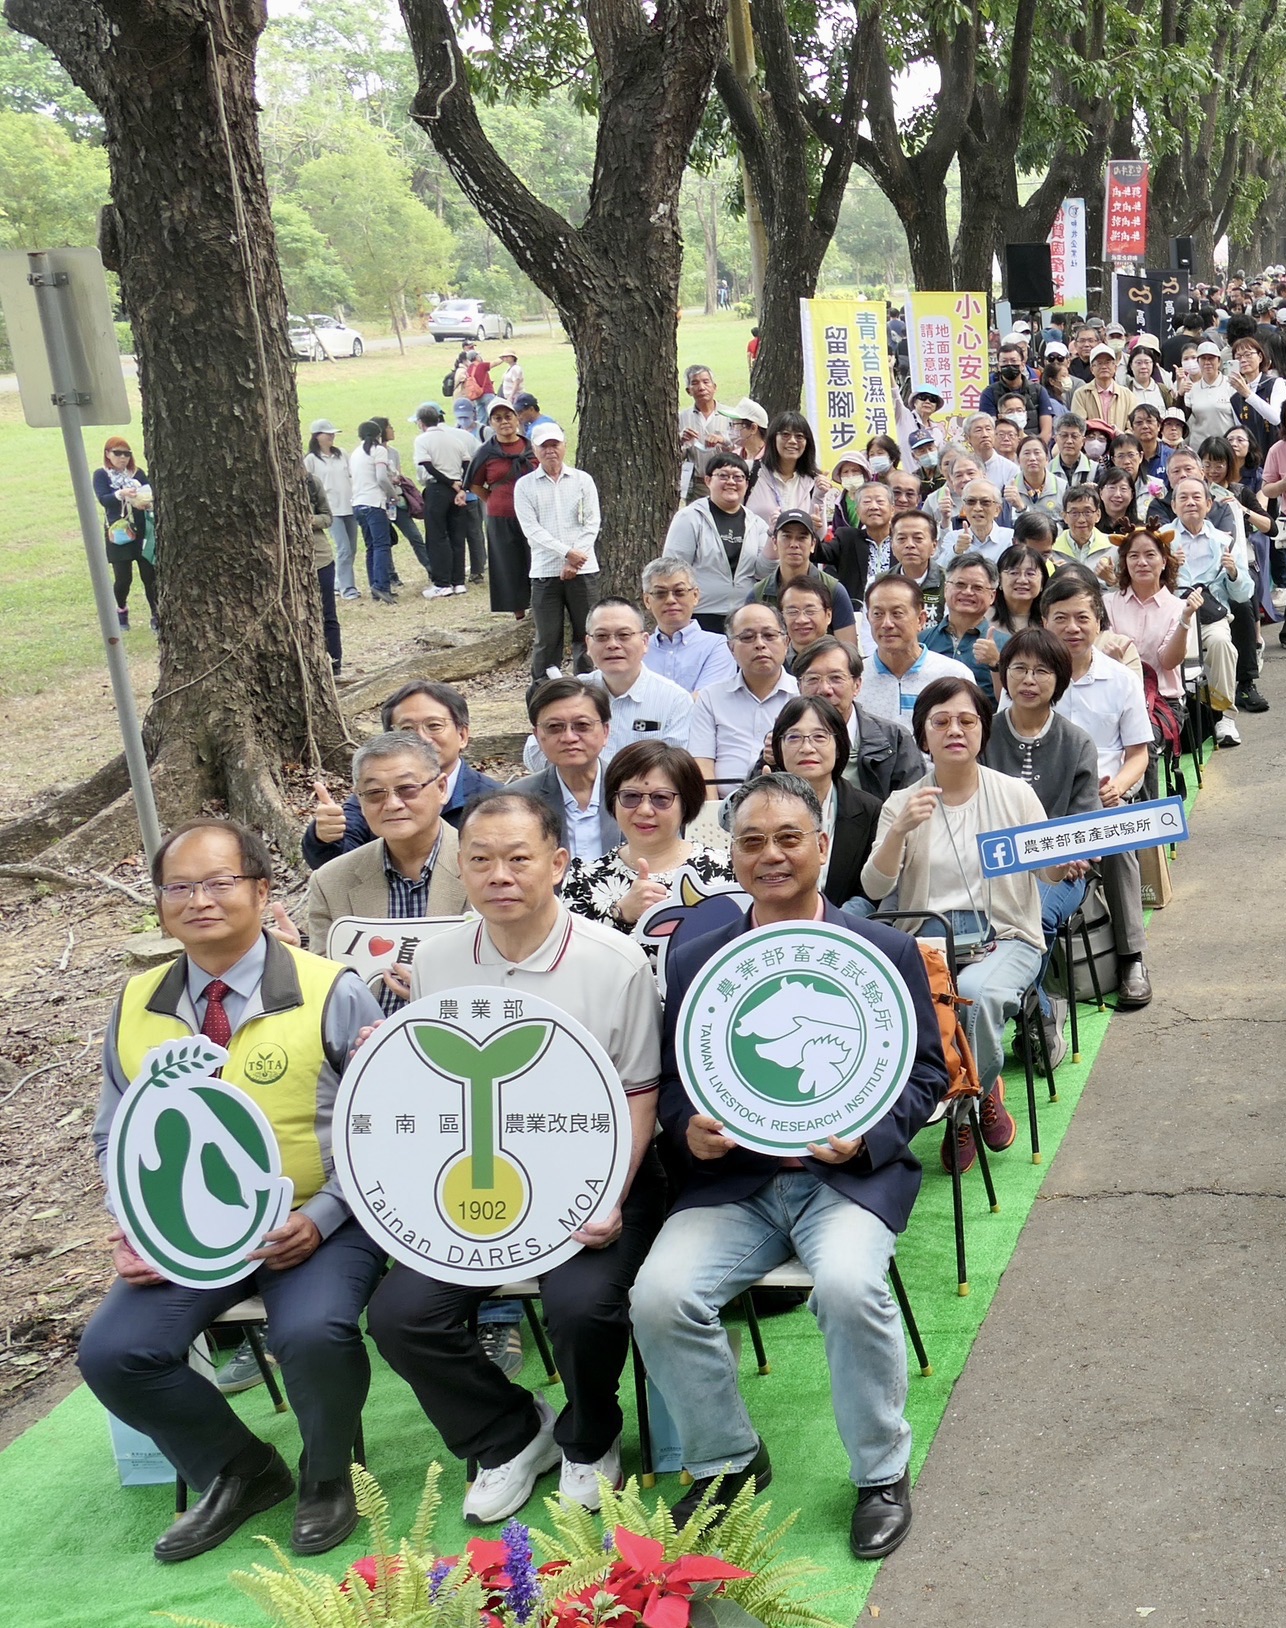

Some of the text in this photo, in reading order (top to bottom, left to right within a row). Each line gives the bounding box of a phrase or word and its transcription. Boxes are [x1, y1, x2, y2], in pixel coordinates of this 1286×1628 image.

[825, 326, 857, 450] 留意腳步
[856, 312, 888, 436] 青苔濕滑
[936, 324, 953, 405] 地面路不平
[955, 294, 983, 410] 小心安全
[1024, 818, 1151, 855] 農業部畜產試驗所
[439, 999, 524, 1019] 農業部
[717, 944, 893, 1031] 農業部畜產試驗所
[700, 1022, 889, 1132] TAIWAN LIVESTOCK RESEARCH INSTITUTE
[351, 1113, 611, 1135] 臺南區 農業改良場
[365, 1180, 434, 1254] Tainan
[558, 1177, 605, 1232] MOA
[458, 1200, 507, 1220] 1902
